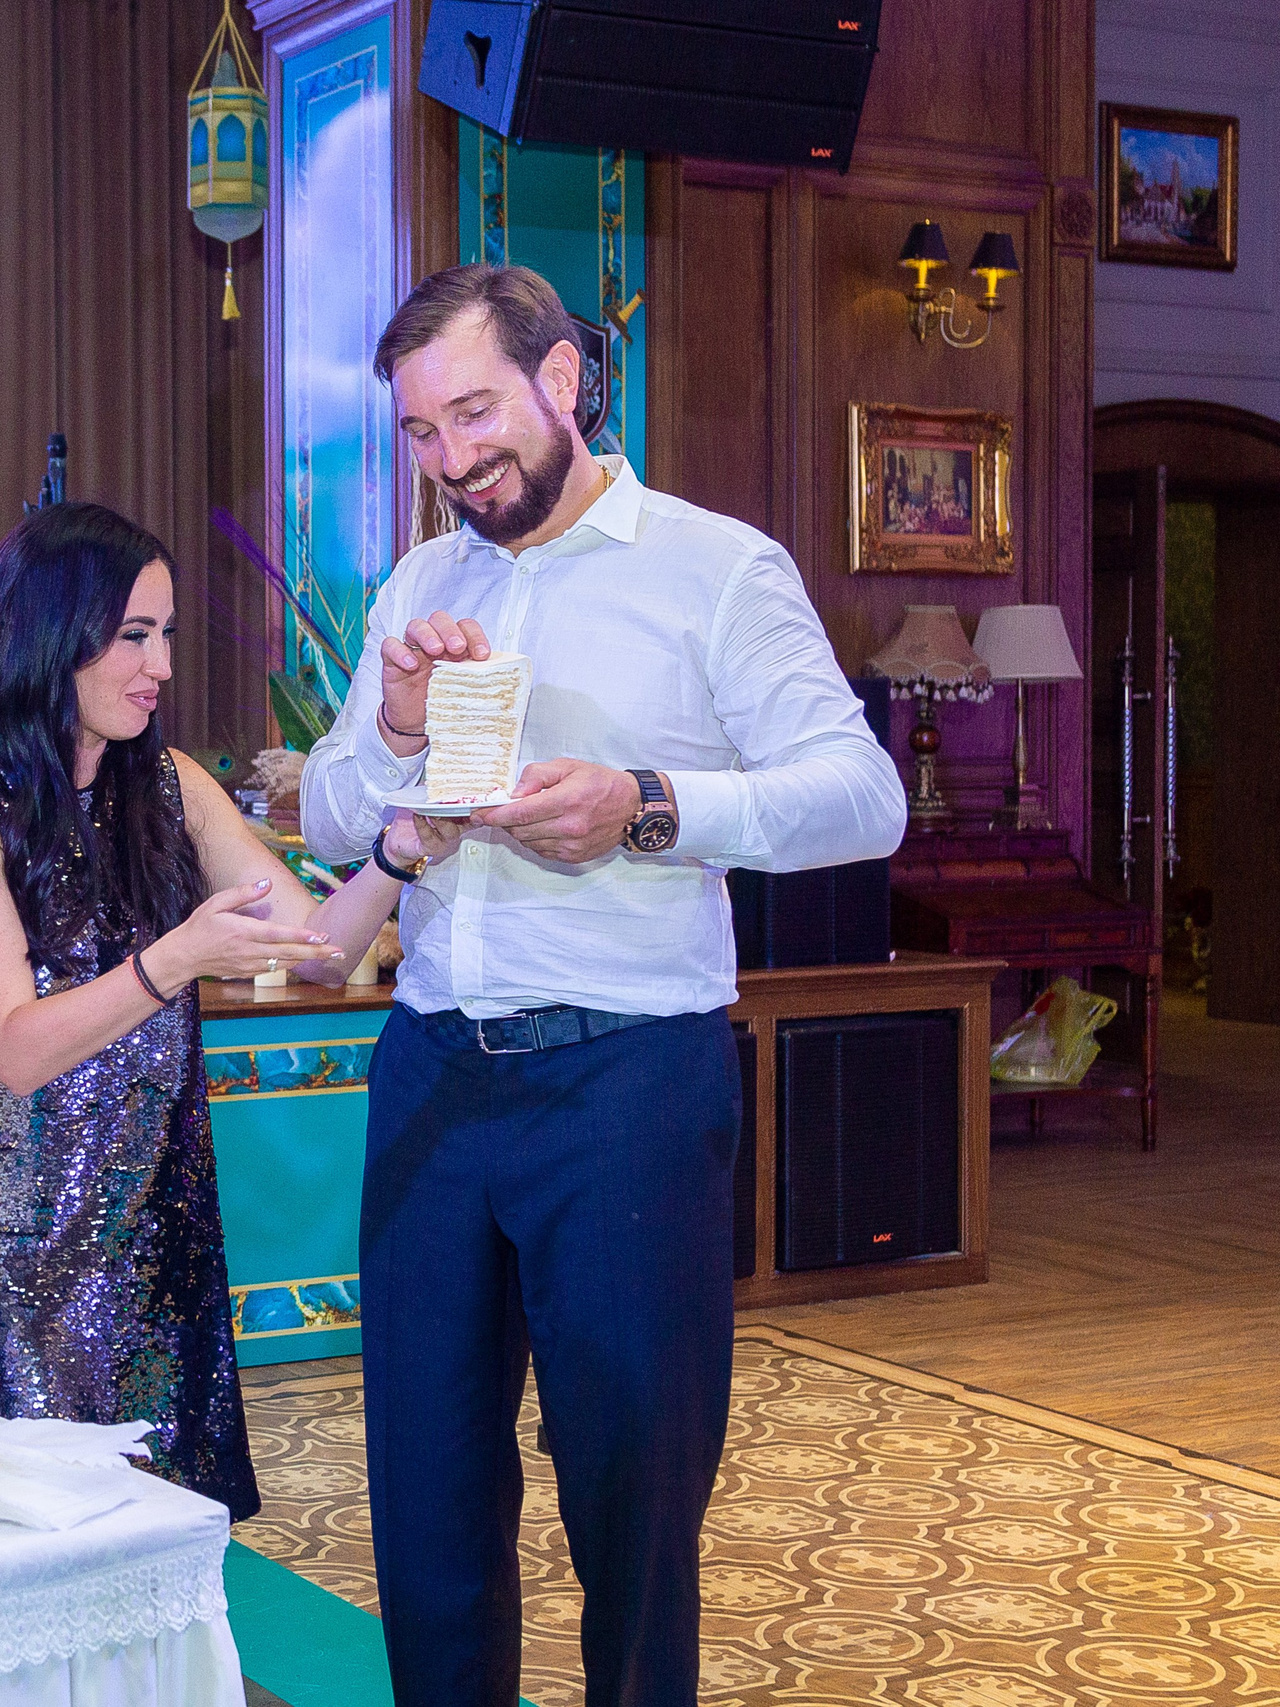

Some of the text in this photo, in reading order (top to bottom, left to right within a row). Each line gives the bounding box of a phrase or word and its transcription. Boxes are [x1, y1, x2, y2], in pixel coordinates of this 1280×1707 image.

[838, 20, 859, 31] LAX
[811, 147, 832, 158] LAX
[873, 1232, 892, 1243] LAX
